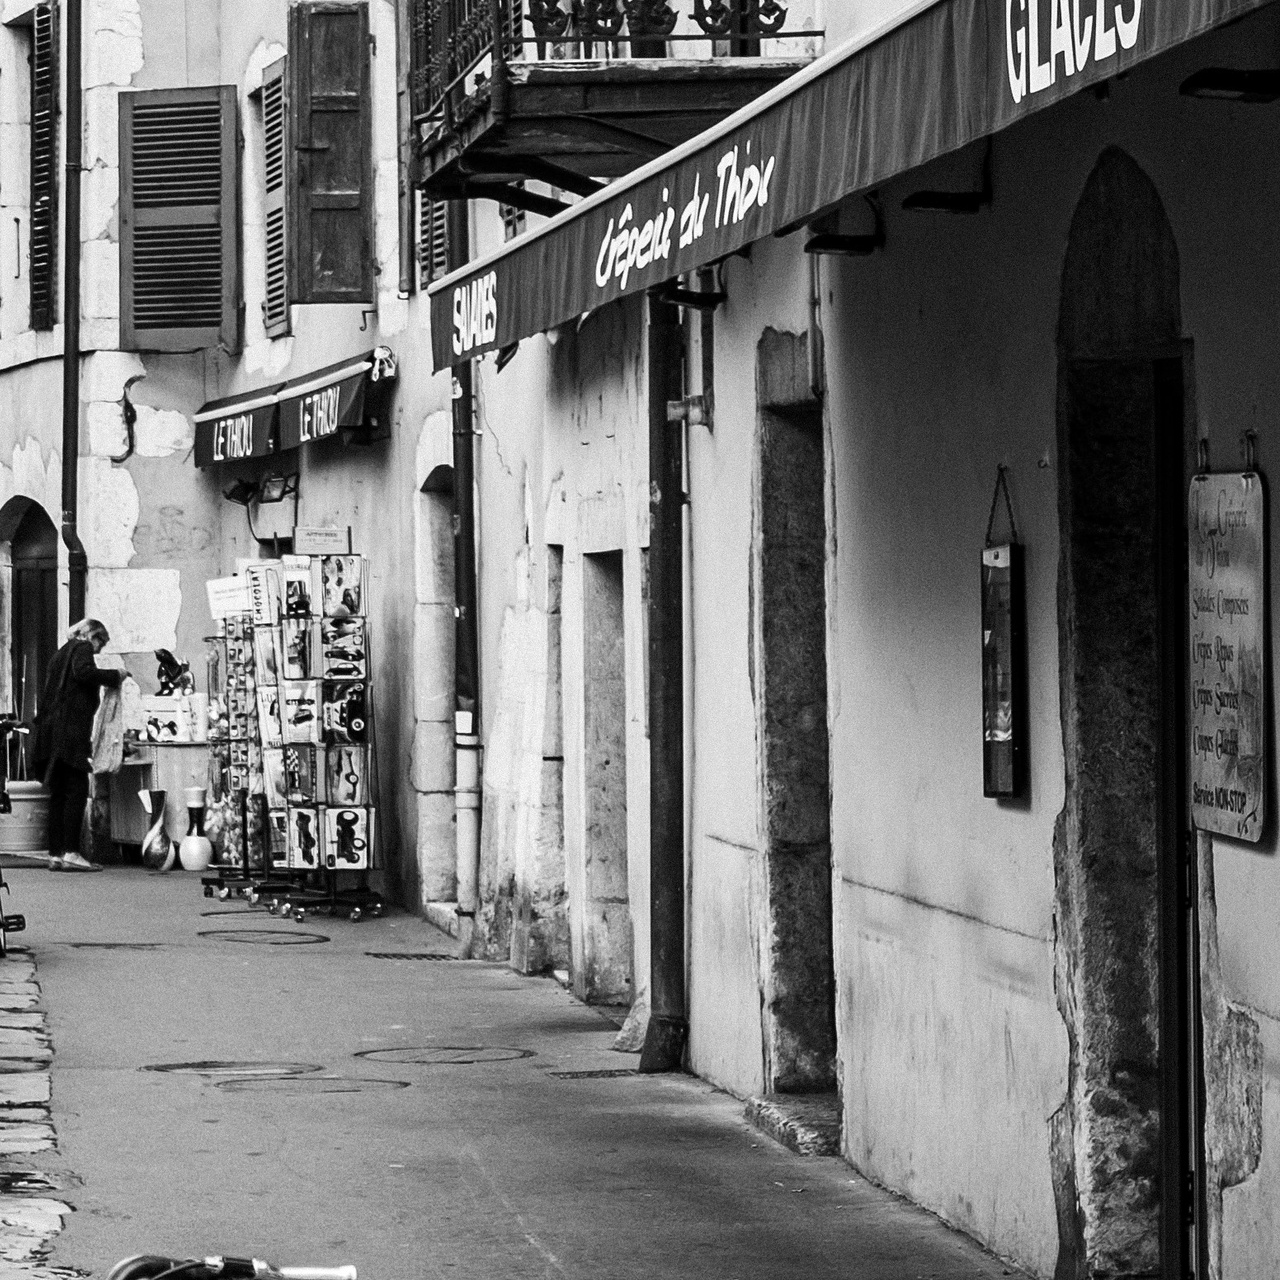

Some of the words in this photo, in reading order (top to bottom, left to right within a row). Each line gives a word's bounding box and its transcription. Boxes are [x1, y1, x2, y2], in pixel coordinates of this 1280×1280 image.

[596, 187, 675, 290] Crêperie
[679, 172, 709, 249] du
[715, 140, 775, 229] Thiou
[453, 271, 497, 356] SALADES
[300, 397, 312, 442] LE
[312, 385, 340, 438] THIOU
[213, 420, 225, 461] LE
[226, 414, 253, 458] THIOU
[251, 570, 264, 622] CHOCOLAT
[1192, 588, 1215, 620] Salades
[1192, 631, 1213, 669] Crêpes
[1192, 678, 1213, 715] Crêpes
[1193, 725, 1213, 761] Coupes
[1193, 781, 1214, 807] Service
[1214, 786, 1247, 814] NON-STOP
